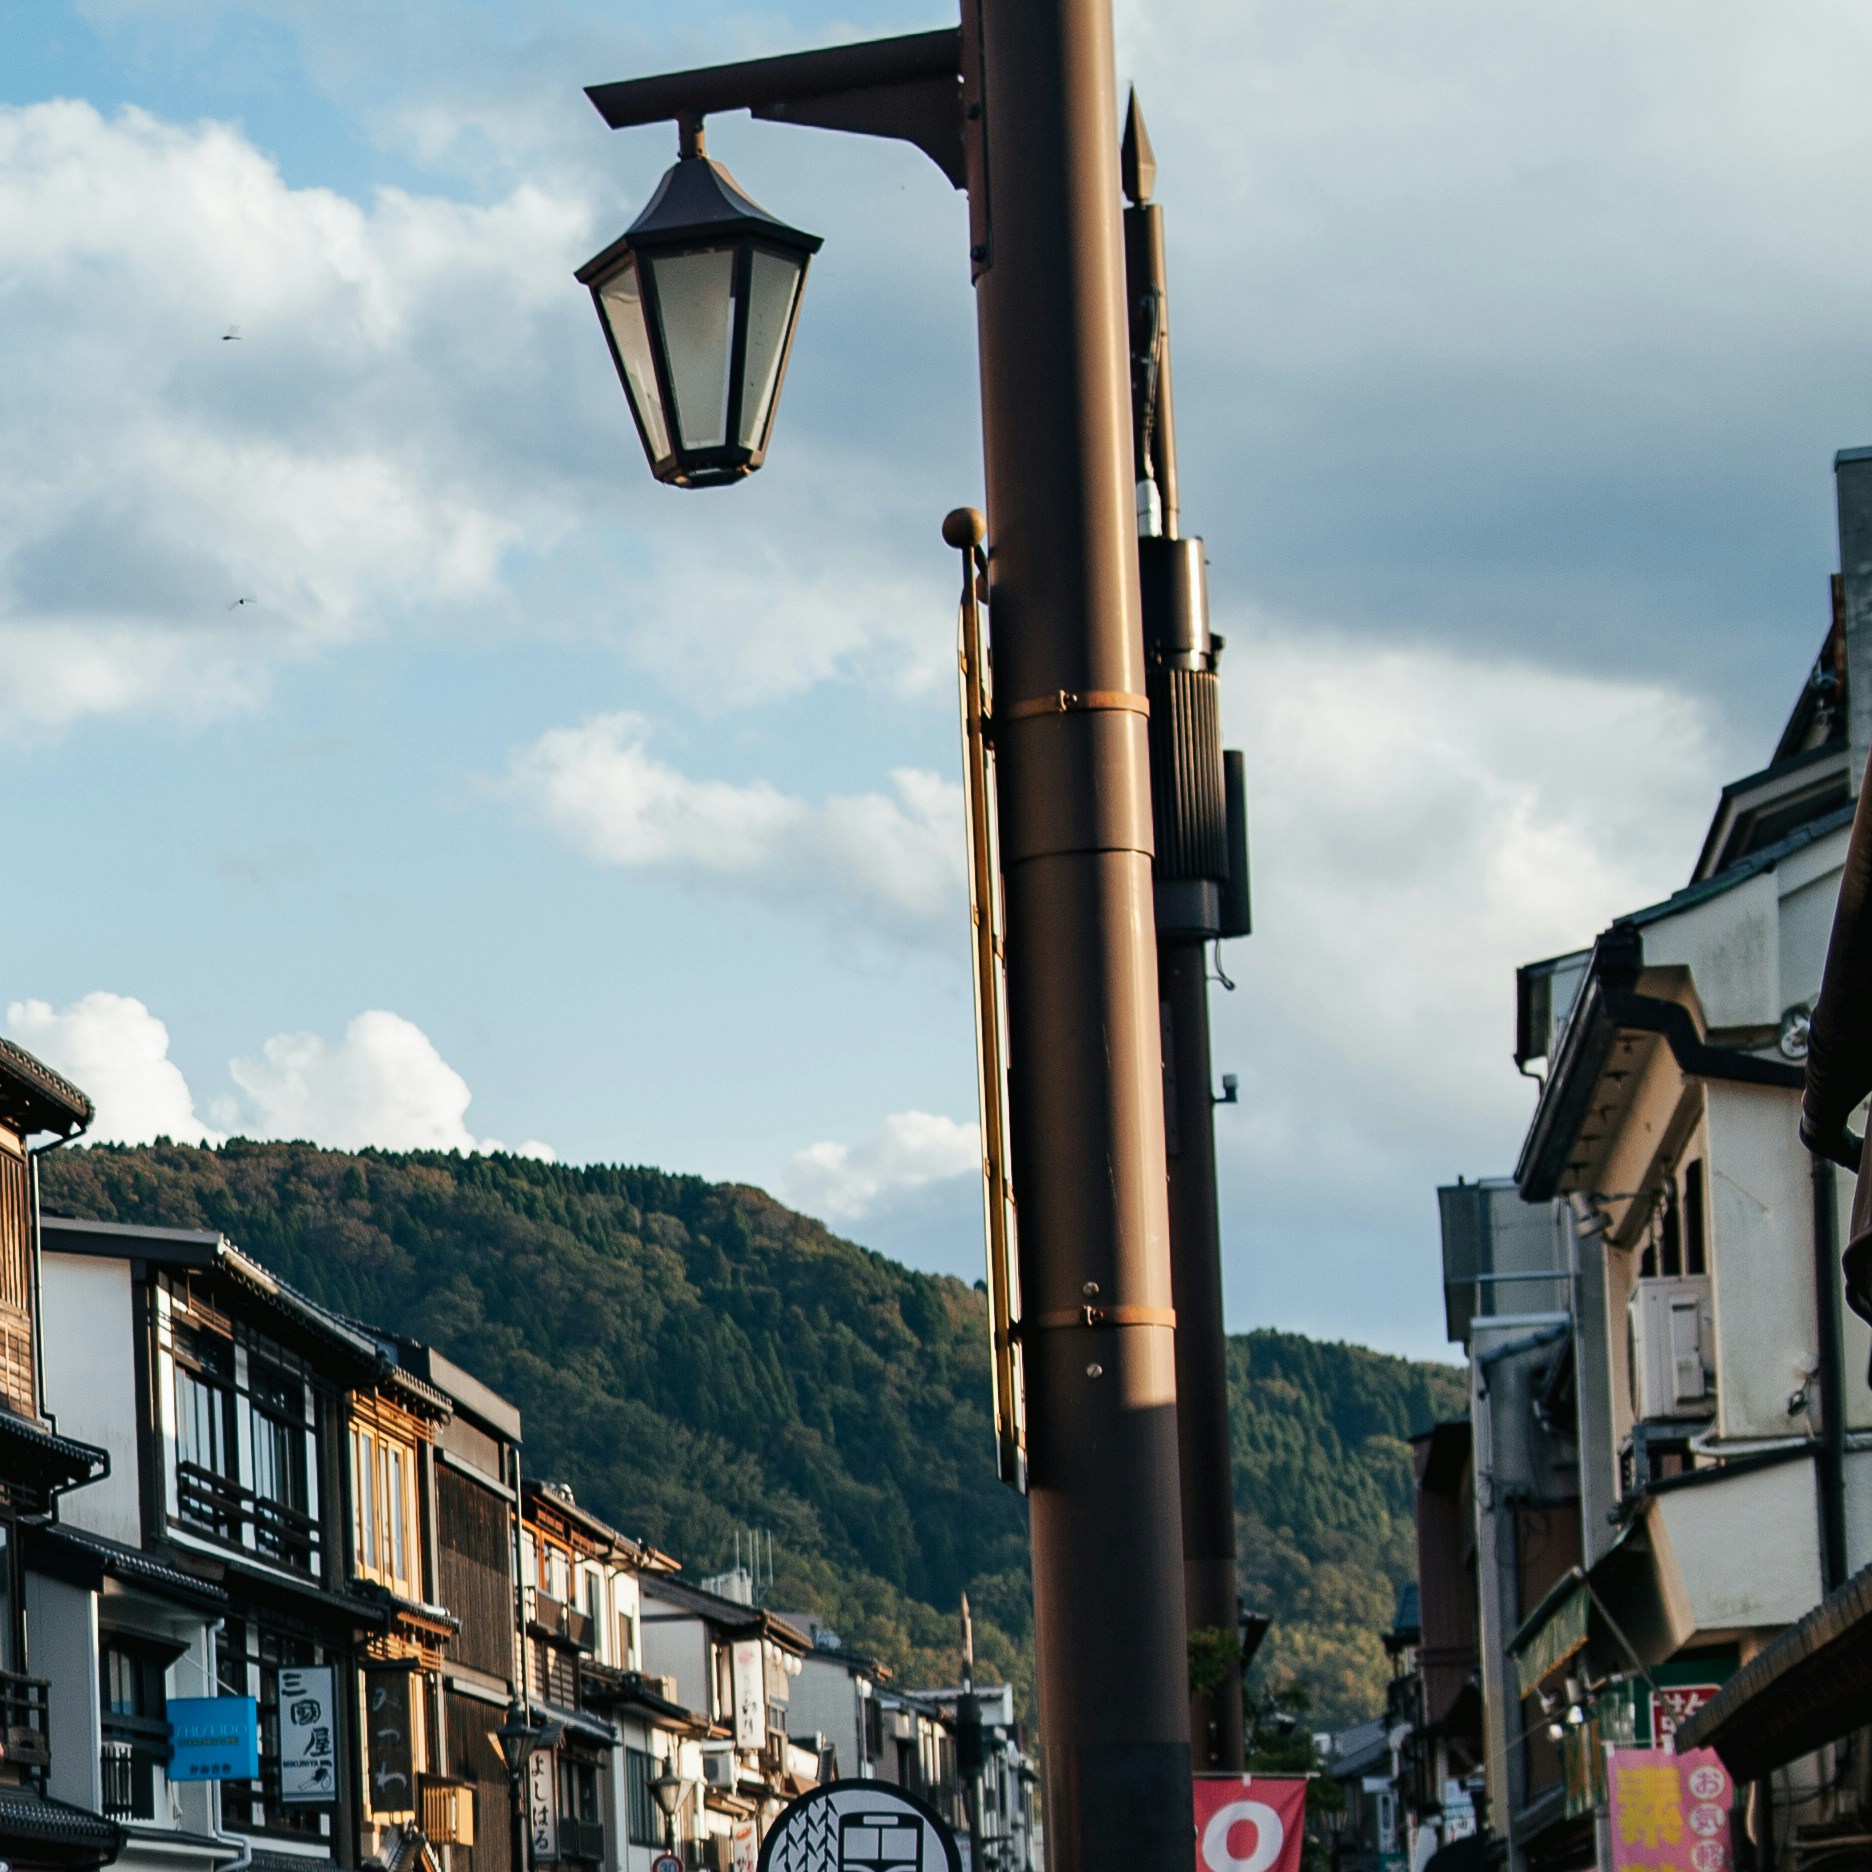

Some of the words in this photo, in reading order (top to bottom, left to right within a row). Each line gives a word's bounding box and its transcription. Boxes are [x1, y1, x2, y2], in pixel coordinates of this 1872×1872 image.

[175, 1724, 248, 1737] SHISEIDO
[531, 1754, 550, 1850] よしはる
